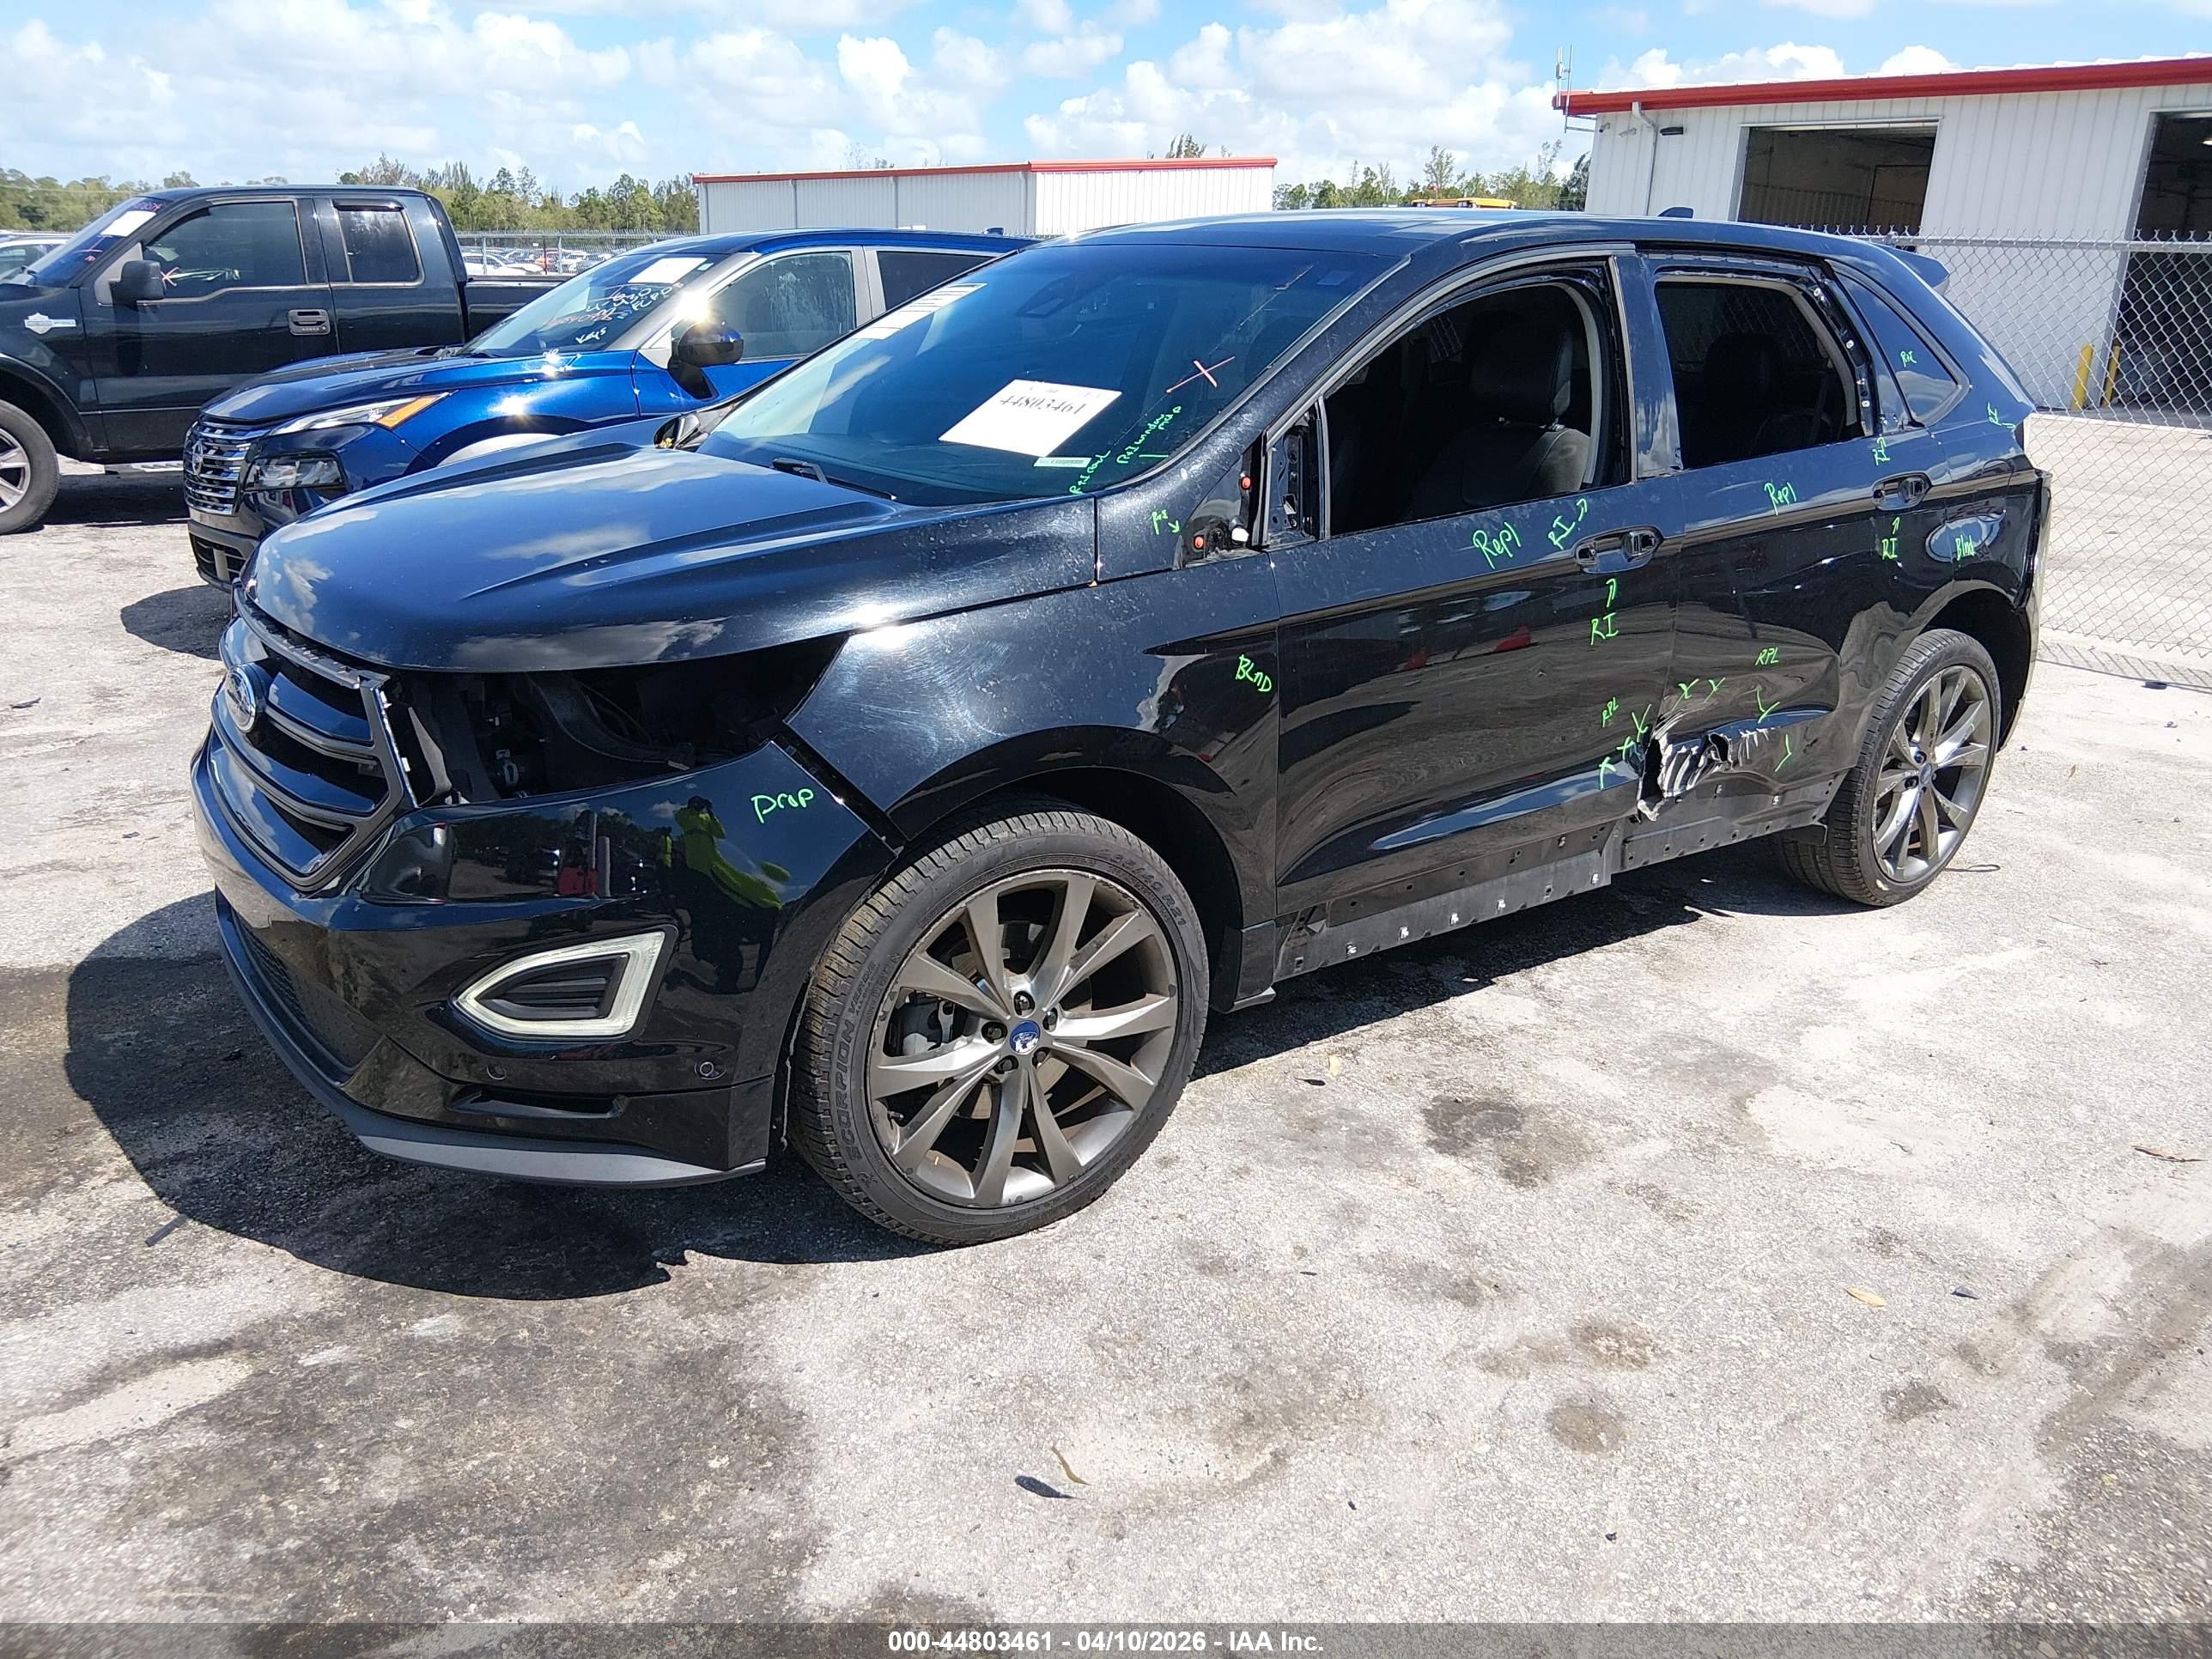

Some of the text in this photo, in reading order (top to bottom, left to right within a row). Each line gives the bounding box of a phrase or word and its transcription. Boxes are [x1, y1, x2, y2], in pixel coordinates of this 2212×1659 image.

[1548, 516, 1576, 550] RI
[1882, 538, 1898, 560] RI
[1590, 612, 1619, 646] RI
[835, 1018, 862, 1161] SCORPION
